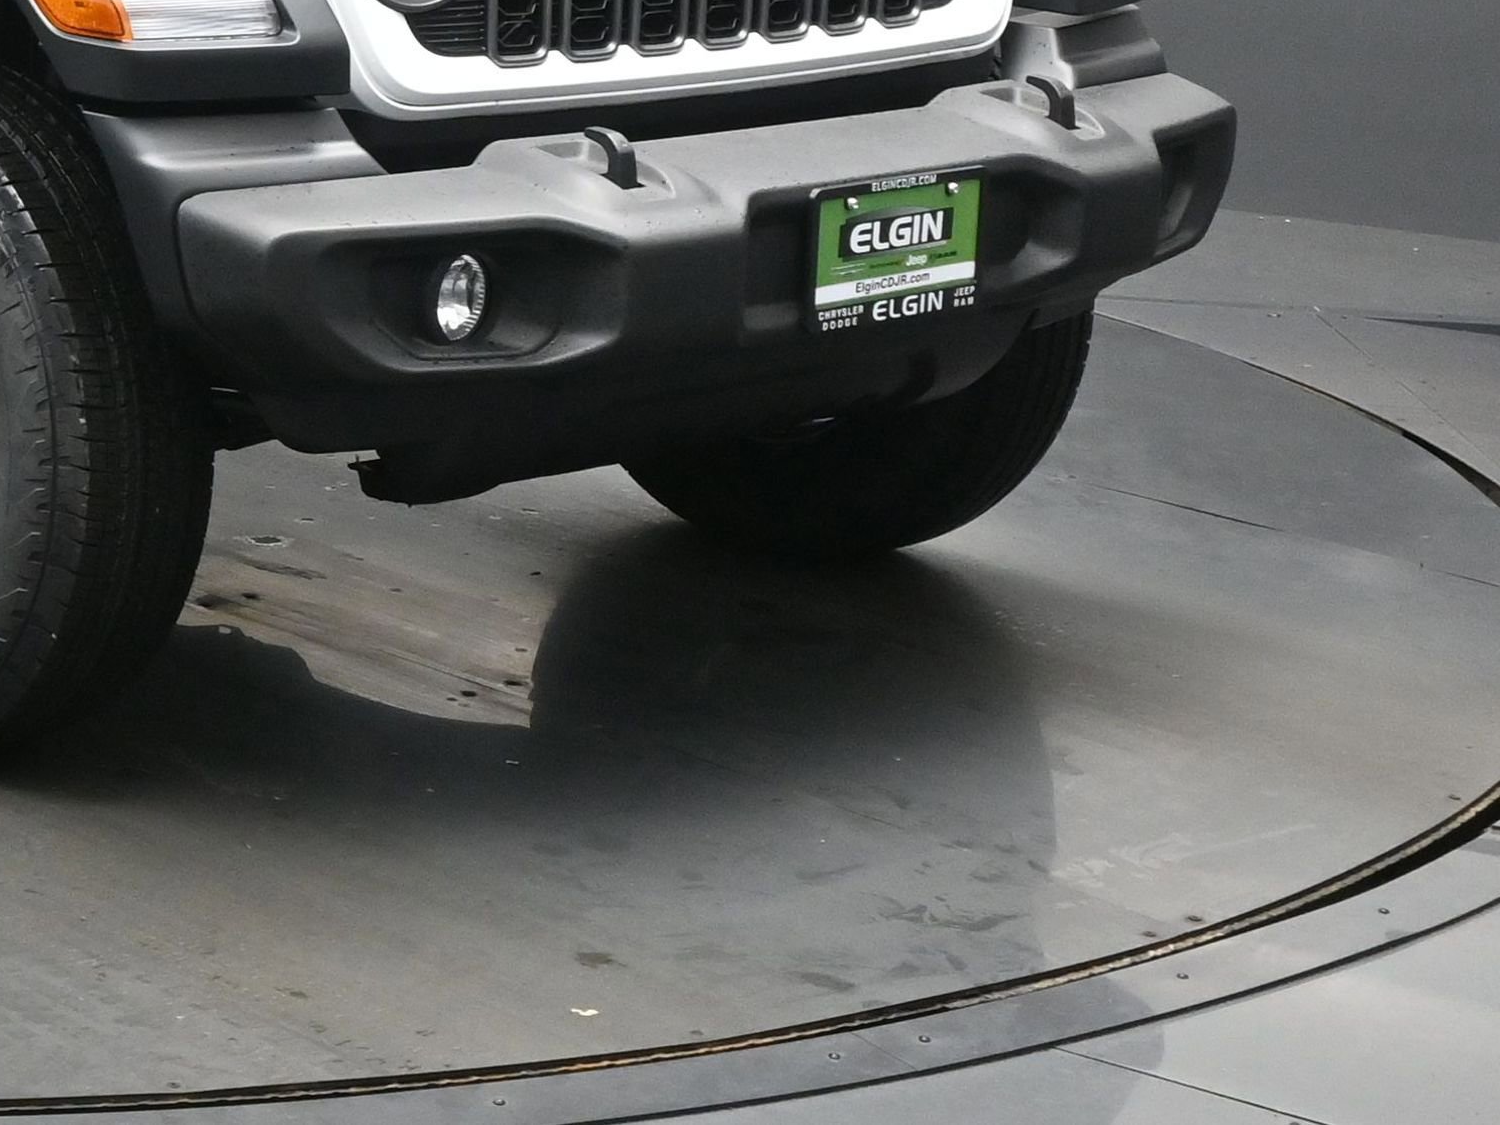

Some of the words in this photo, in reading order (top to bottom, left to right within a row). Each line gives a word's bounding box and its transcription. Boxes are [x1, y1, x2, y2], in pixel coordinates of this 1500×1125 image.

[871, 174, 938, 192] ELGINCDJR.COM
[849, 211, 944, 254] ELGIN
[905, 253, 928, 267] Jeep
[855, 272, 931, 295] ElginCDJR.com
[953, 285, 976, 297] JEEP
[872, 290, 944, 322] ELGIN
[953, 296, 975, 308] RAM
[818, 305, 864, 321] CHRYSLER
[821, 316, 858, 332] DODGE
